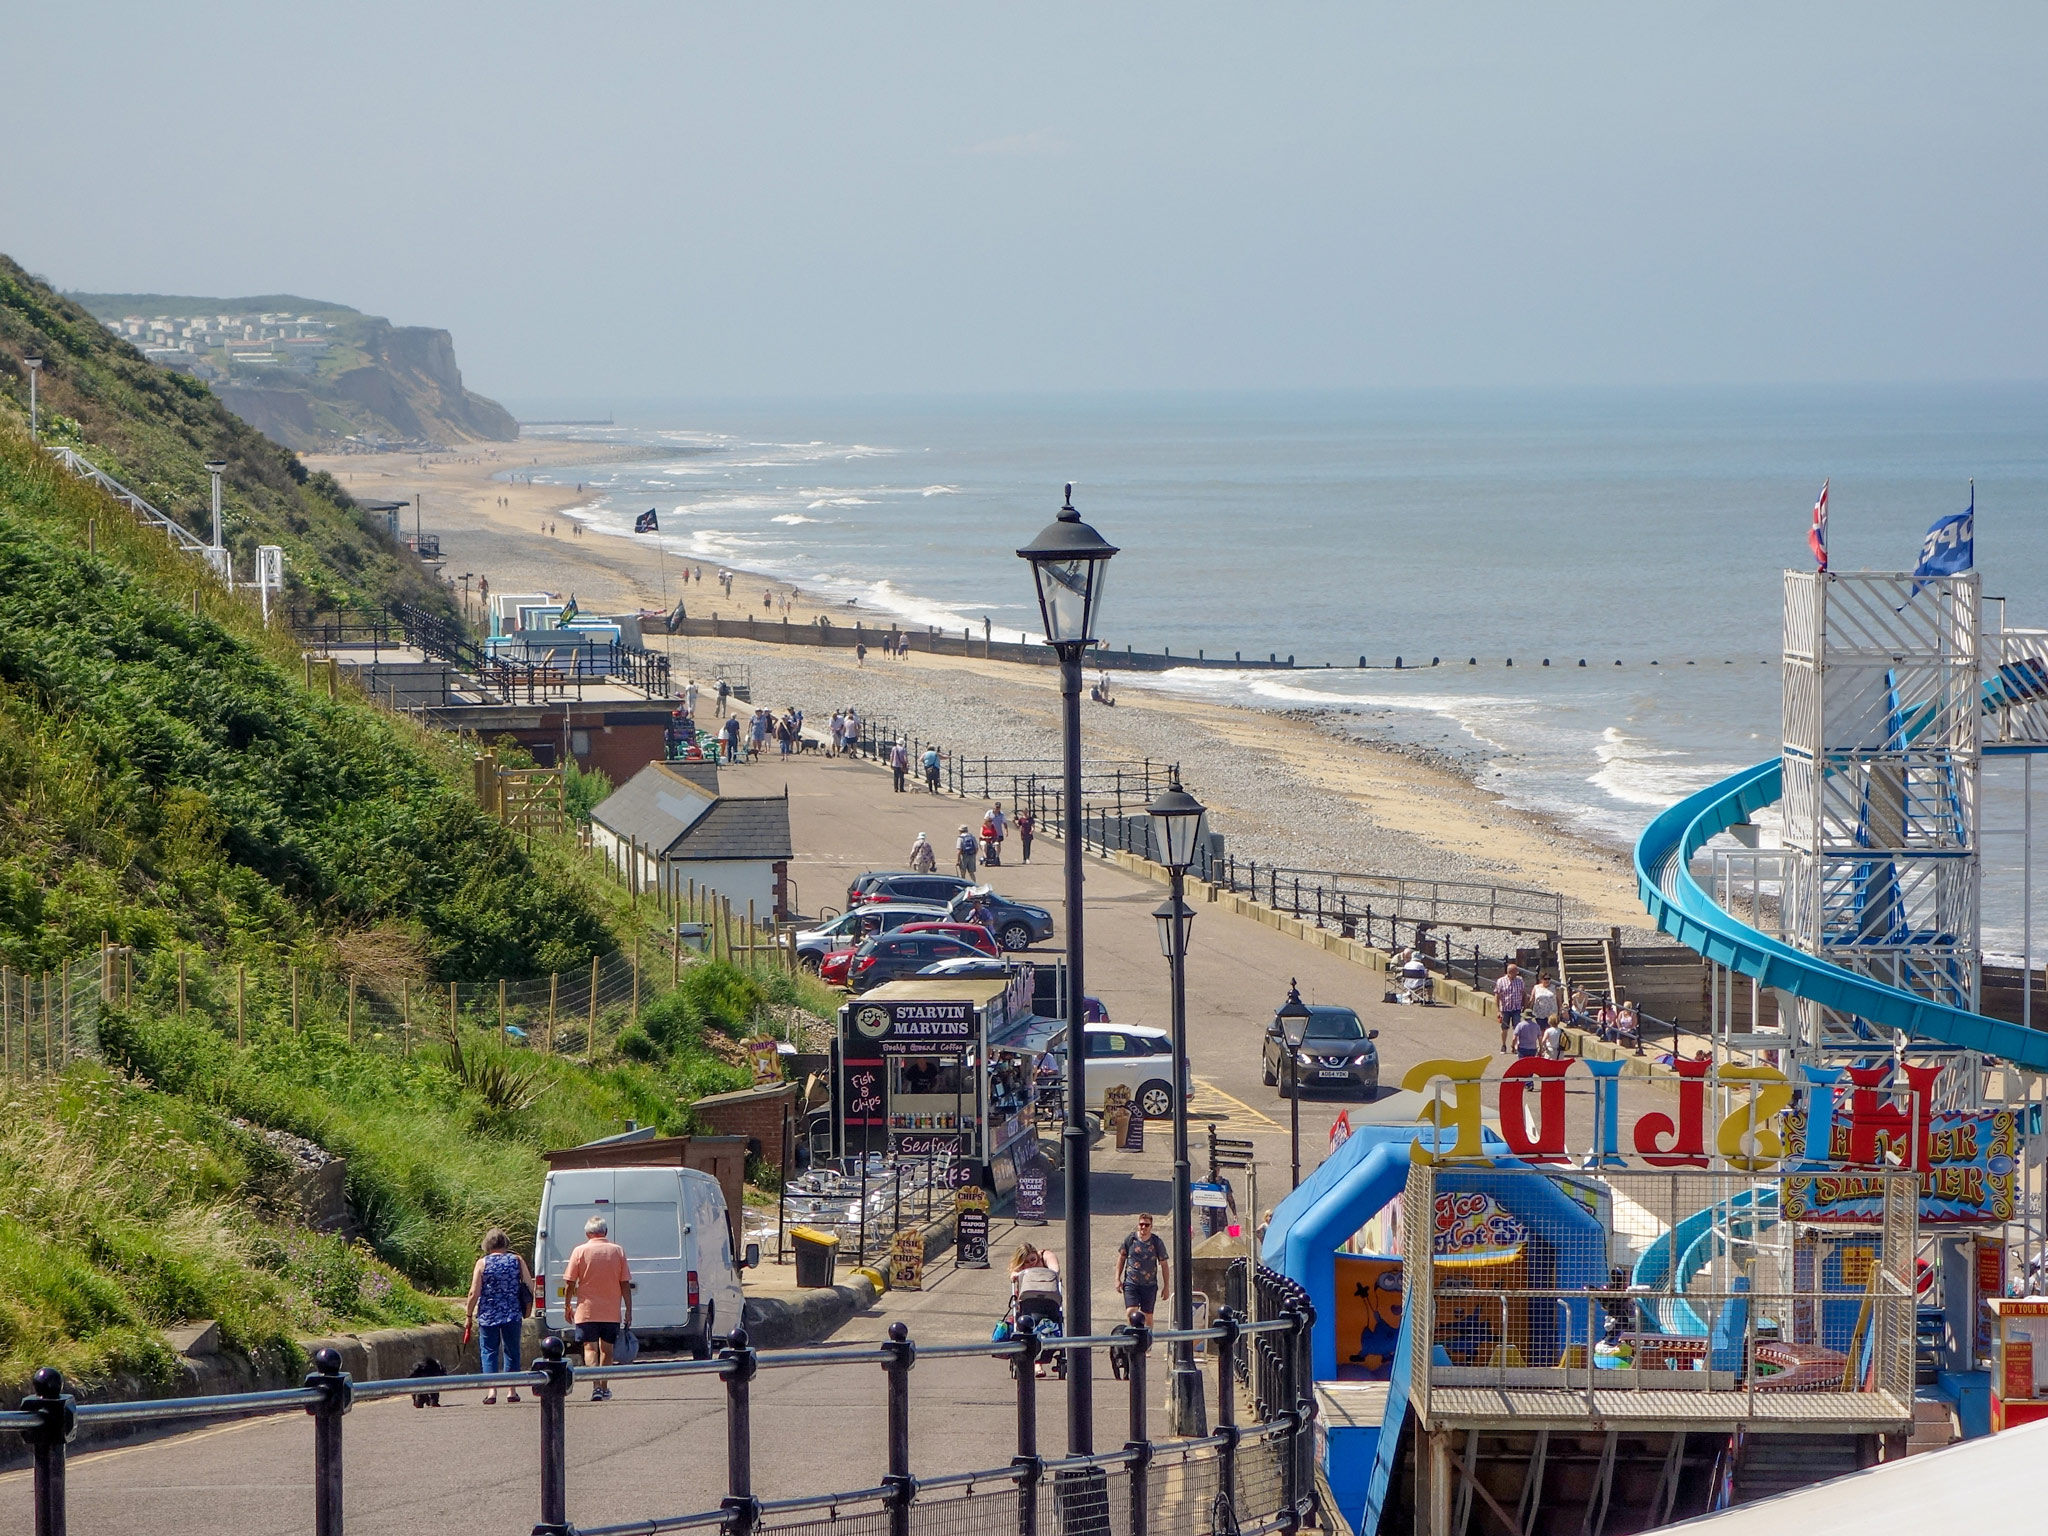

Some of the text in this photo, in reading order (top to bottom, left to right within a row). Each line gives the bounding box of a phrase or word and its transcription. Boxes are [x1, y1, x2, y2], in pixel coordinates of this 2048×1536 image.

[896, 1006, 966, 1019] STARVIN
[893, 1022, 969, 1035] MARVINS
[750, 1040, 776, 1052] CHIPS
[851, 1071, 876, 1089] Fish
[860, 1086, 869, 1097] &
[851, 1095, 881, 1113] Chips
[1032, 1196, 1044, 1206] £3
[1434, 1192, 1487, 1229] Ice
[1433, 1221, 1488, 1251] Hot
[896, 1239, 918, 1247] FISH
[893, 1254, 920, 1263] CHIPS
[896, 1266, 915, 1281] £5
[2001, 1304, 2016, 1314] BUY
[2018, 1304, 2038, 1314] YOUR
